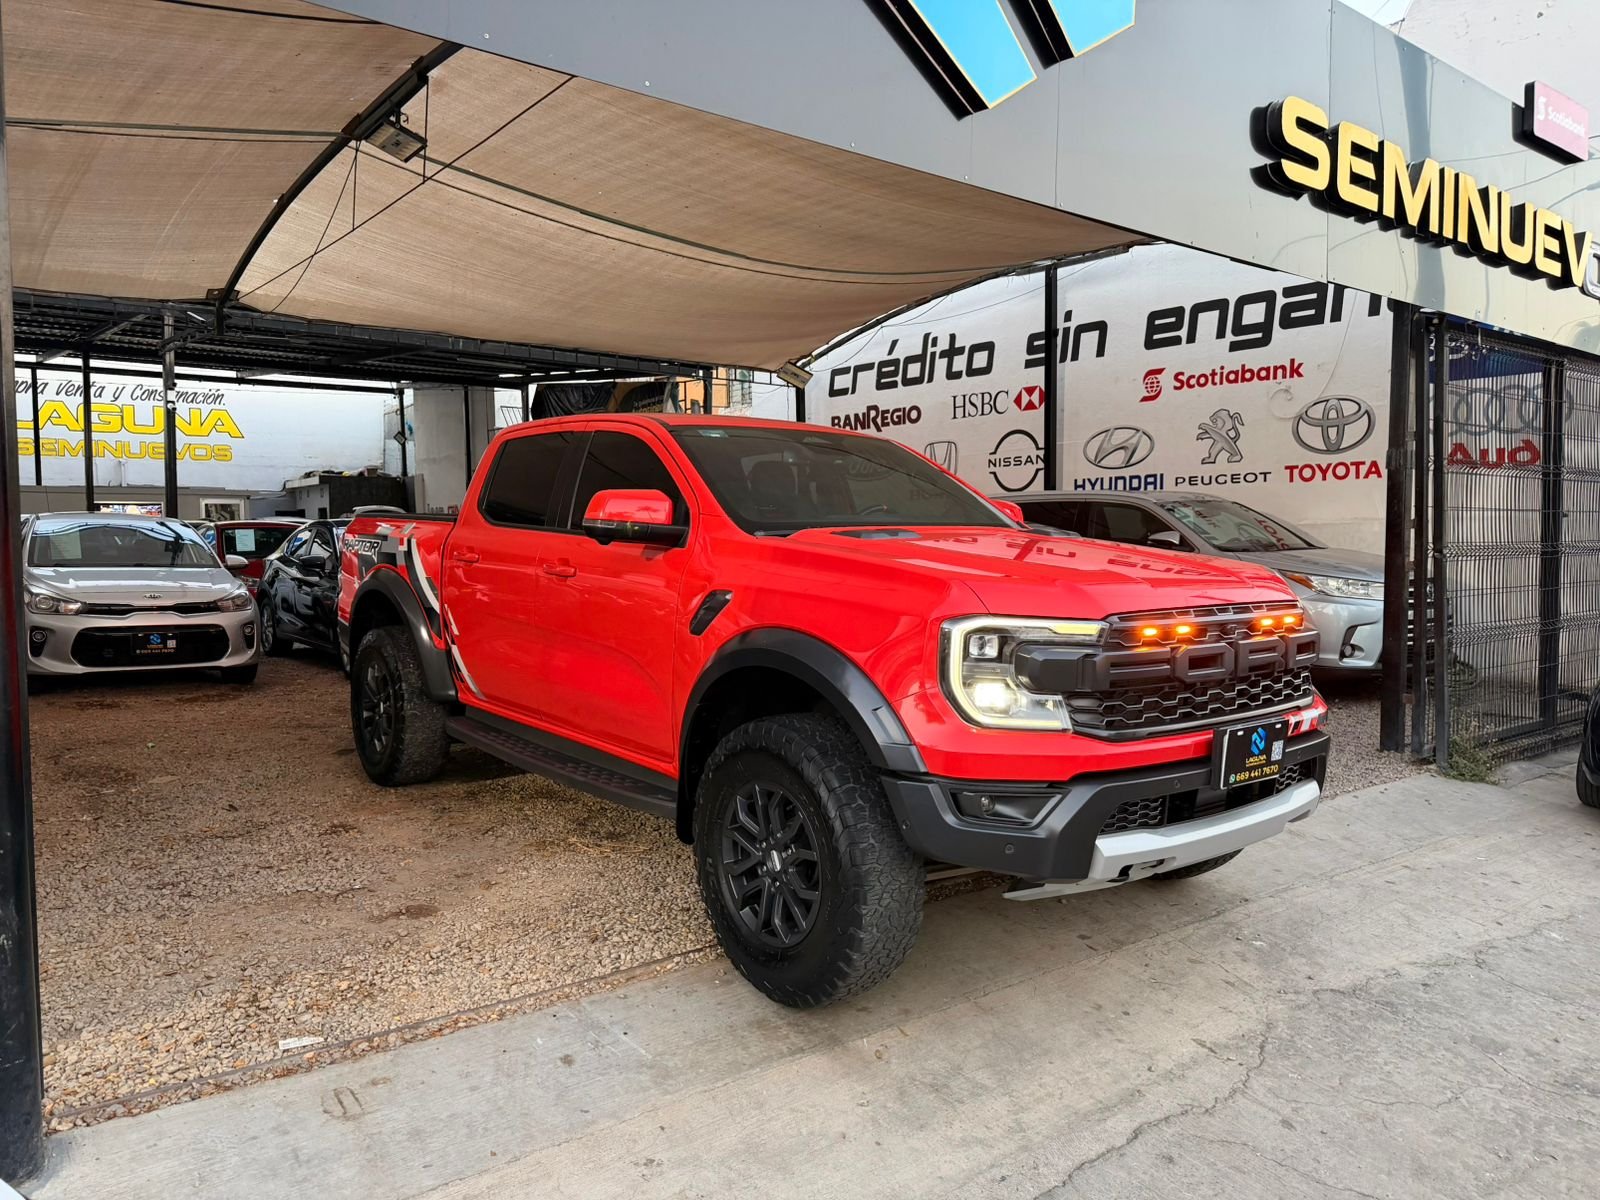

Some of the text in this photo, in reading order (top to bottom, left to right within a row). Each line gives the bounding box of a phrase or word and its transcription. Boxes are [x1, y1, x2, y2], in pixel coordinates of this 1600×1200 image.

[828, 331, 996, 398] crédito
[1024, 309, 1108, 369] sin
[1172, 358, 1304, 391] Scotiabank
[130, 383, 226, 406] Consnación.
[951, 390, 1009, 420] HSBC
[987, 454, 1046, 469] NISSAN
[1446, 439, 1541, 469] Aud
[1074, 473, 1165, 492] HYUNDAI
[1174, 471, 1273, 487] PEUGEOT
[1284, 459, 1383, 484] TOYOTA
[345, 538, 382, 564] RAPTOR
[1096, 630, 1320, 692] FORD
[1245, 754, 1267, 764] LAGUNA
[1236, 770, 1249, 782] 669
[1250, 767, 1262, 778] 441
[1262, 764, 1279, 775] 7670
